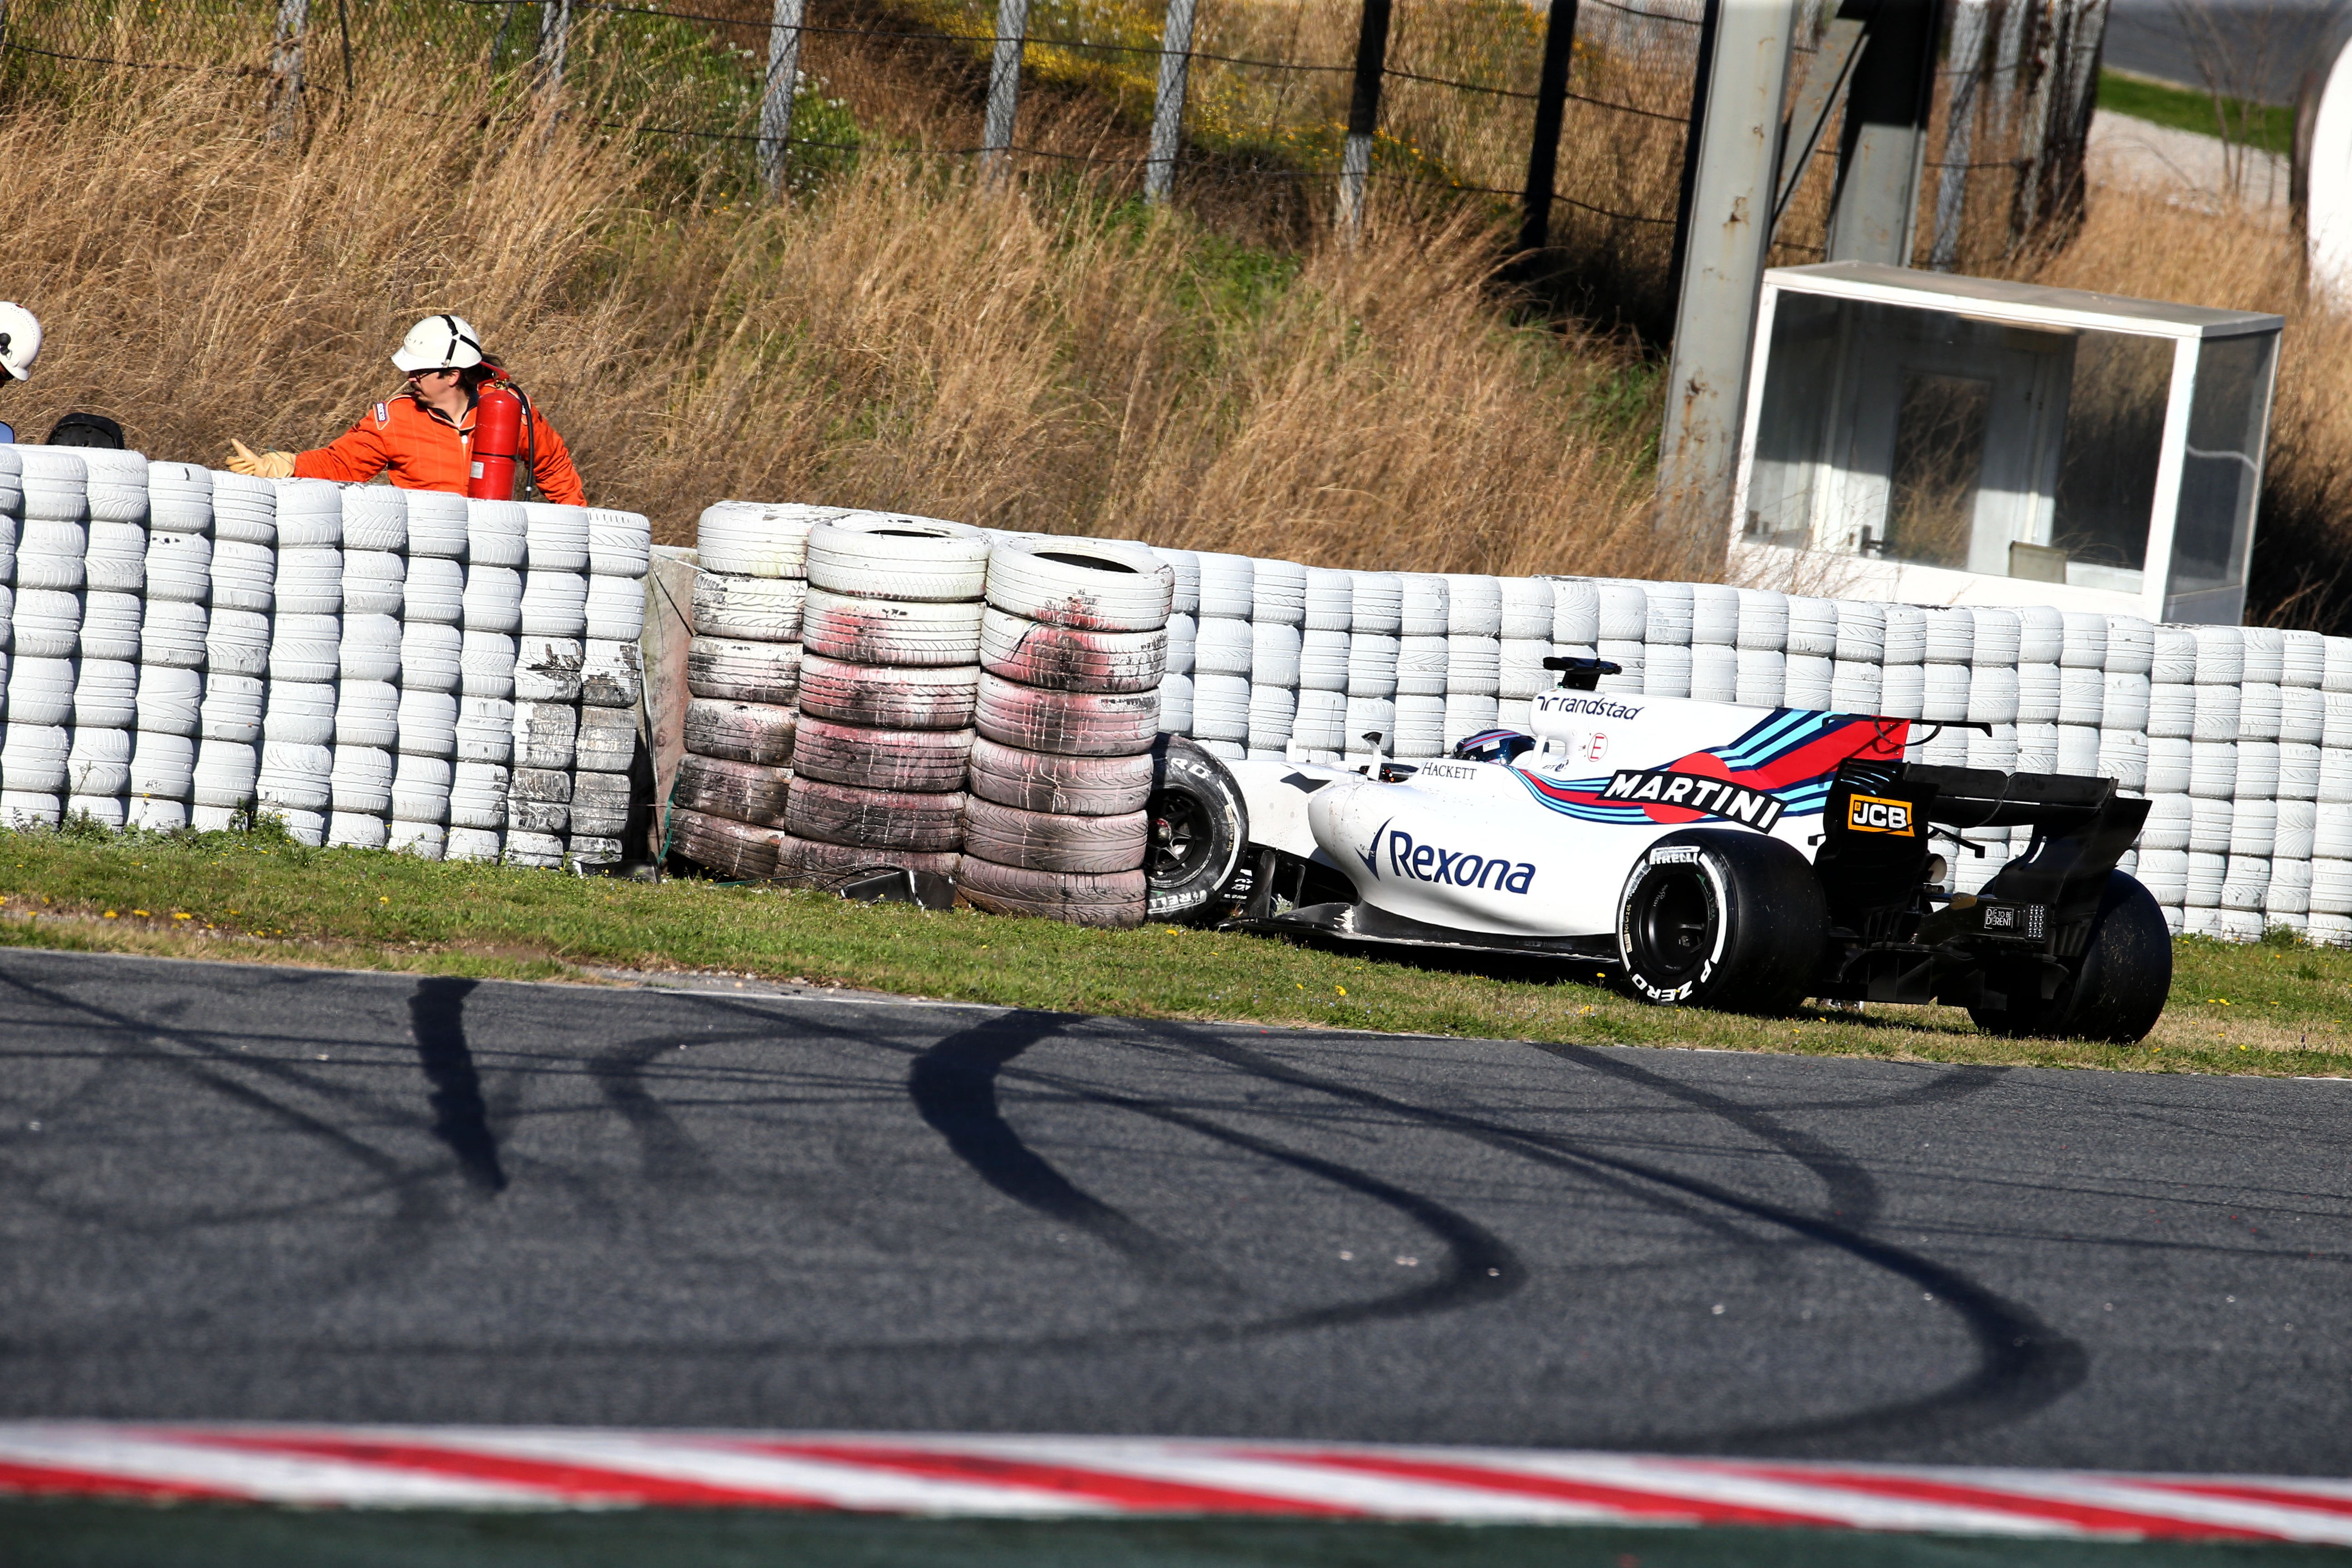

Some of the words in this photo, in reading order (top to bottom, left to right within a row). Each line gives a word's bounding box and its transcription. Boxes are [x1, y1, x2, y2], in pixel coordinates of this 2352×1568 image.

[1558, 697, 1645, 720] randstad
[1590, 736, 1605, 760] E
[1421, 762, 1477, 779] HACKETT
[1604, 774, 1781, 829] MARTINI
[1853, 803, 1907, 829] JCB
[1390, 830, 1536, 894] Rexona
[1632, 974, 1693, 1002] ZERO
